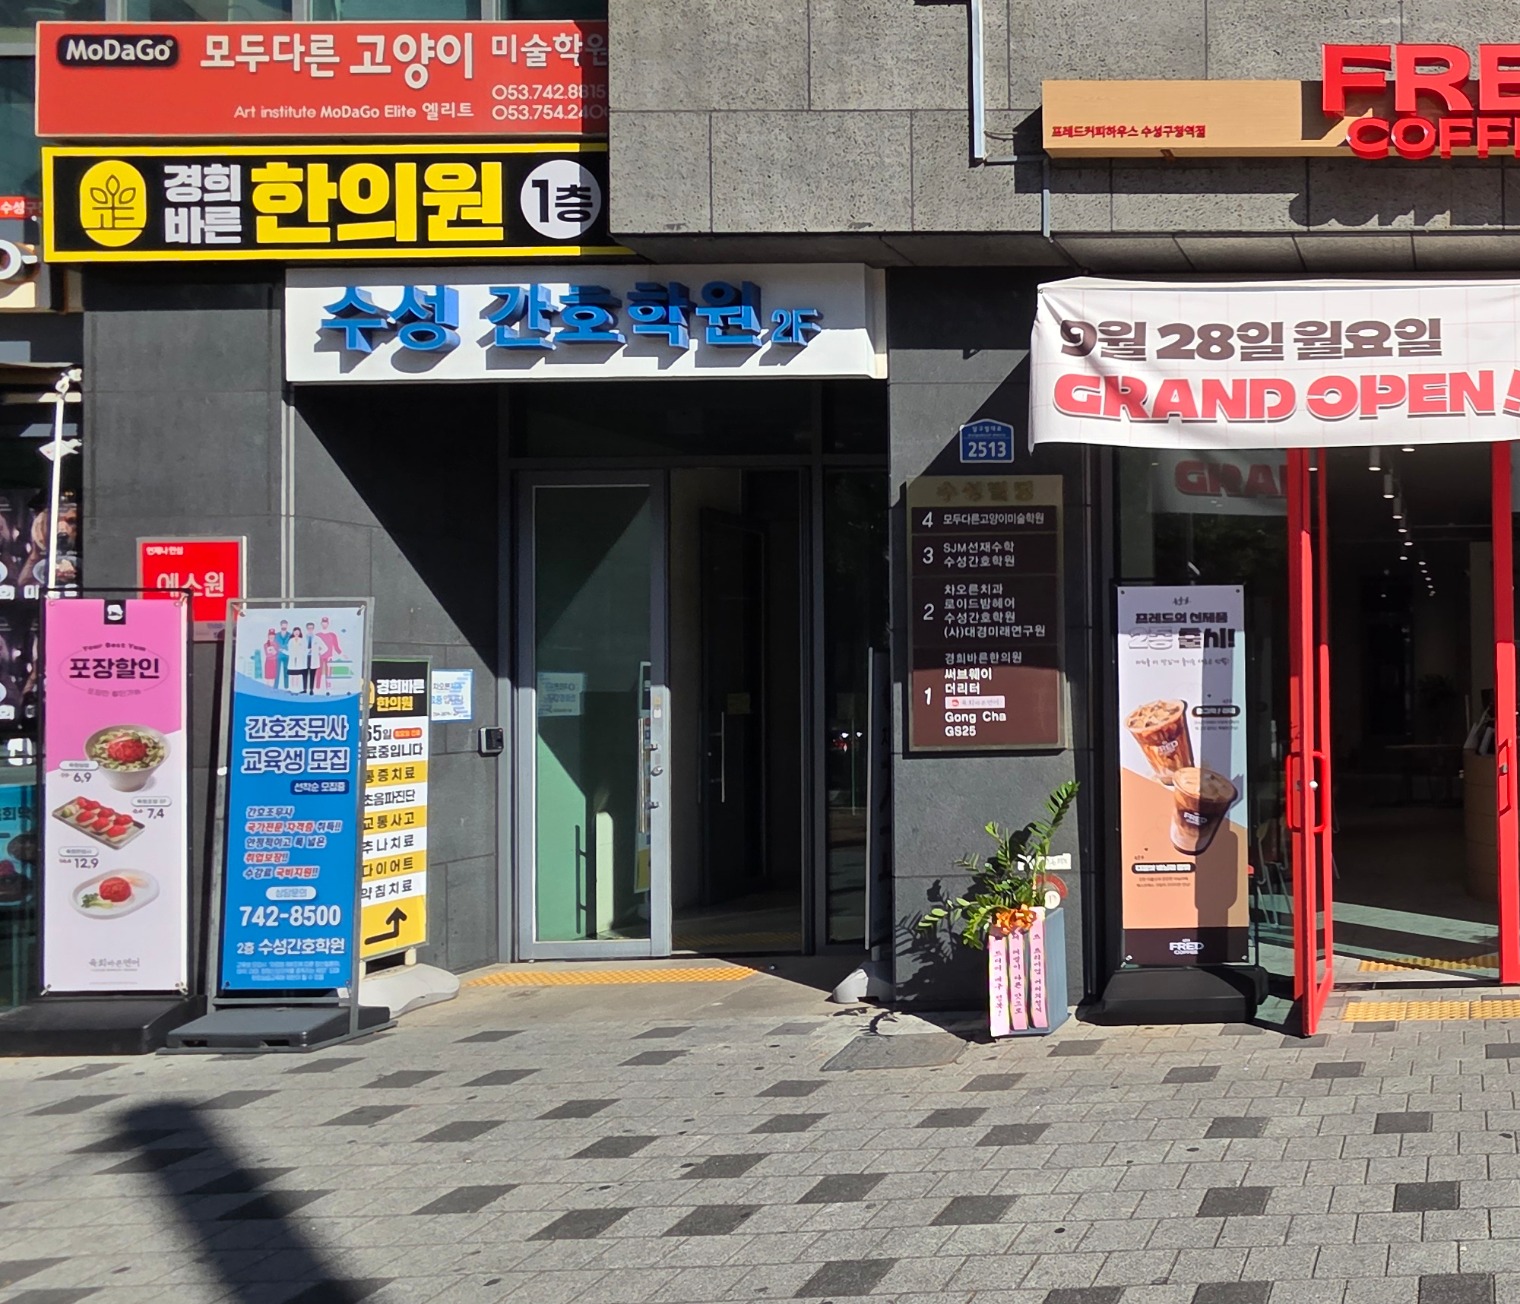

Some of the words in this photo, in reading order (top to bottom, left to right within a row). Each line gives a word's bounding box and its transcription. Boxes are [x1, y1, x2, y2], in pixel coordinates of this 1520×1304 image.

[66, 39, 170, 61] MoDaGo
[200, 33, 340, 78] 모두다른
[350, 32, 473, 89] 고양이
[492, 33, 608, 67] 미술학원
[234, 106, 256, 118] Art
[261, 106, 316, 118] institute
[320, 105, 380, 118] MoDaGo
[385, 105, 417, 118] Elite
[422, 102, 474, 121] 엘리트
[1052, 125, 1139, 138] 프레드커피하우스
[164, 165, 241, 203] 경희
[251, 161, 504, 243] 한의원
[530, 179, 594, 225] 1층
[164, 206, 242, 244] 바른
[321, 285, 460, 352] 수성
[486, 280, 765, 350] 간호학원
[770, 308, 821, 347] 2F
[1060, 320, 1147, 361] 9월
[1156, 321, 1284, 361] 28일
[1293, 317, 1442, 361] 월요일
[1053, 372, 1297, 423] GRAND
[968, 441, 1007, 458] 2513
[922, 512, 933, 528] 4
[943, 512, 1044, 525] 모두다른고양이미술학원
[923, 547, 934, 564] 3
[943, 541, 1015, 554] SJM선재수학
[943, 555, 1015, 568] 수성간호학원
[923, 603, 935, 621] 2
[944, 611, 1015, 624] 수성간호학원
[945, 651, 1022, 665] 경희바른한의원
[69, 658, 160, 679] 포장할인
[944, 667, 992, 681] 써브웨이
[376, 679, 425, 694] 경희바른
[945, 682, 981, 695] 더리터
[376, 696, 413, 712] 한의원
[924, 687, 932, 705] 1
[945, 712, 977, 724] Gong
[982, 711, 1007, 722] Cha
[246, 716, 349, 741] 간호조무사
[945, 726, 977, 737] GS25
[366, 743, 423, 759] 료중입니다
[241, 748, 303, 773] 교육생
[307, 747, 349, 773] 모집
[246, 806, 294, 818] 간호조무사
[363, 812, 415, 830] 교통사고
[363, 834, 414, 854] 추나치료
[363, 857, 413, 877] 다이어트
[239, 905, 341, 926] 742-8500
[258, 938, 345, 955] 수성간호학원
